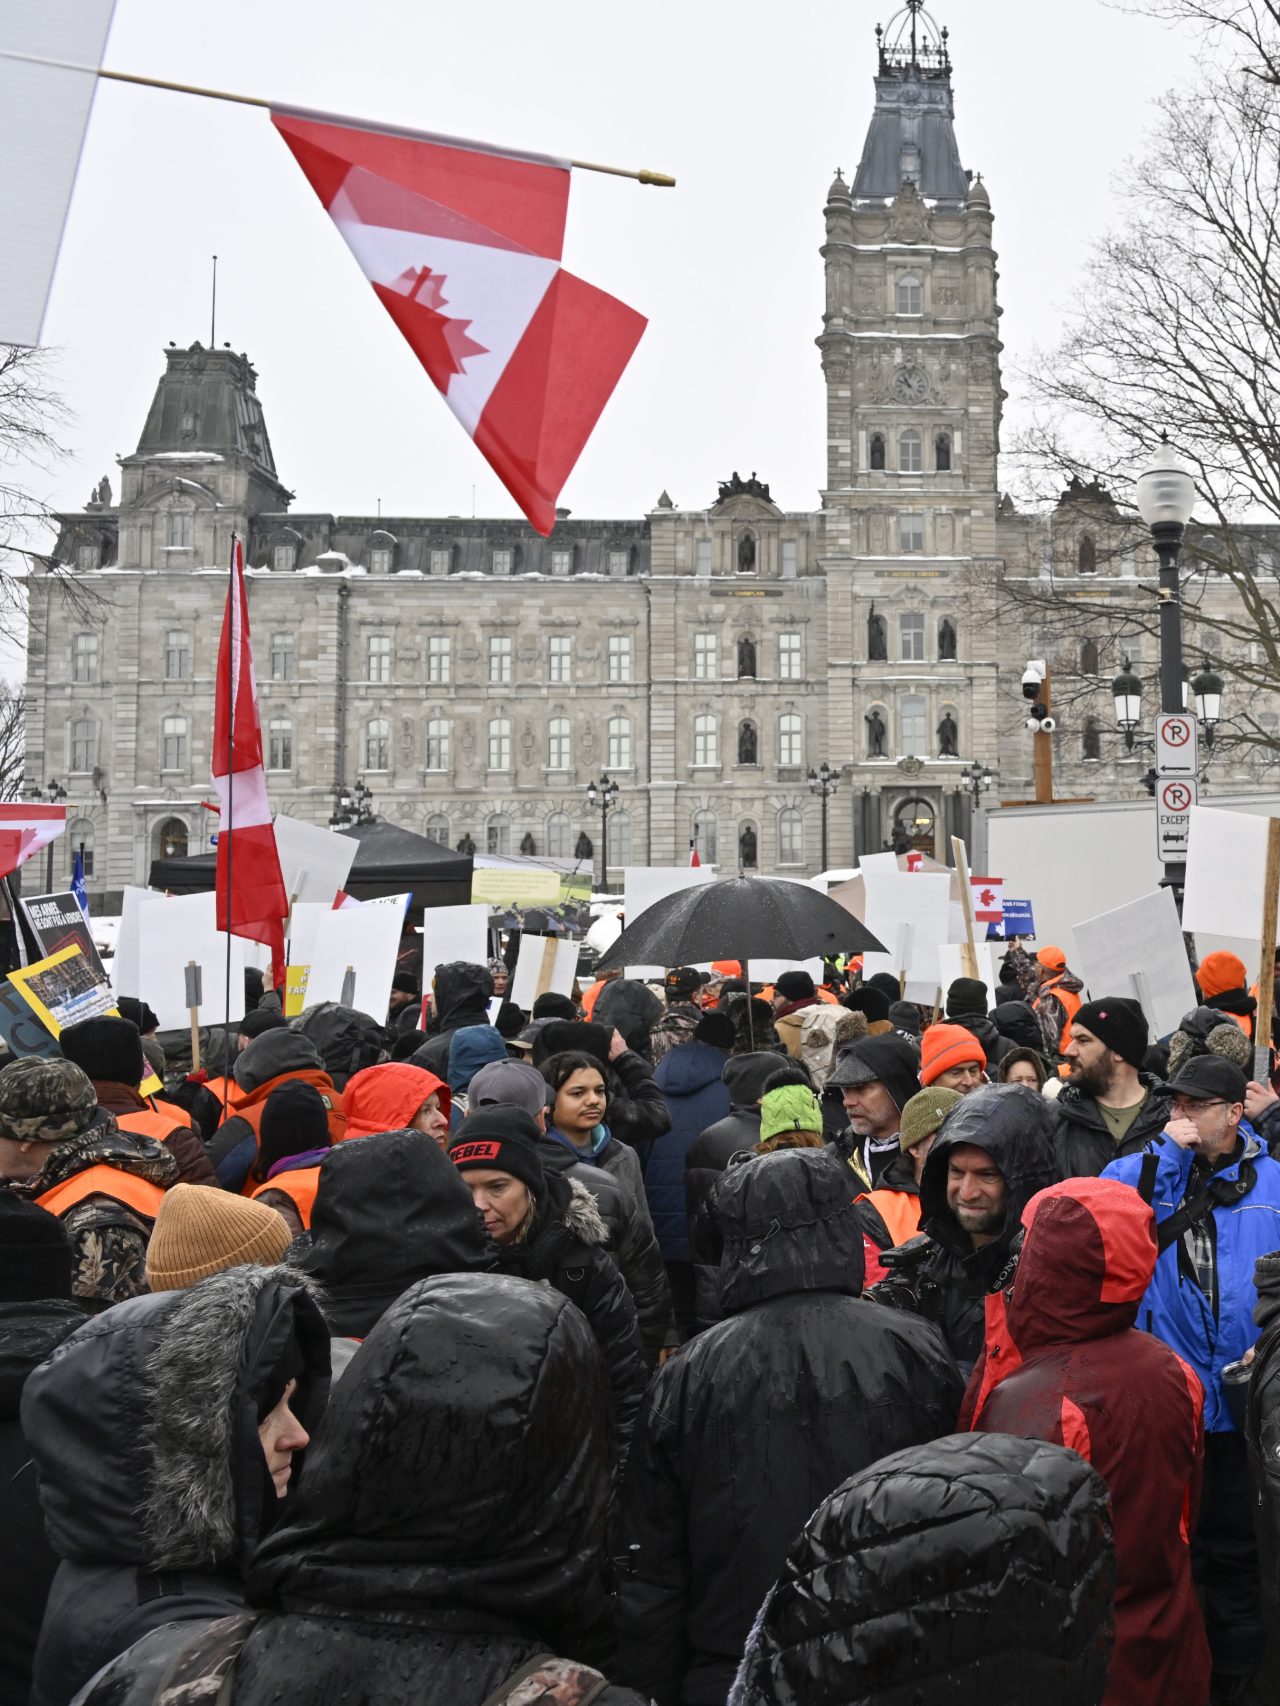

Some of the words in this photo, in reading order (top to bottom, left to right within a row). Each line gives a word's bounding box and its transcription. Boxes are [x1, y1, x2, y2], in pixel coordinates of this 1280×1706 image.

[1160, 815, 1190, 825] EXCEPT
[450, 1143, 493, 1161] REBEL
[993, 1254, 1019, 1290] SONY
